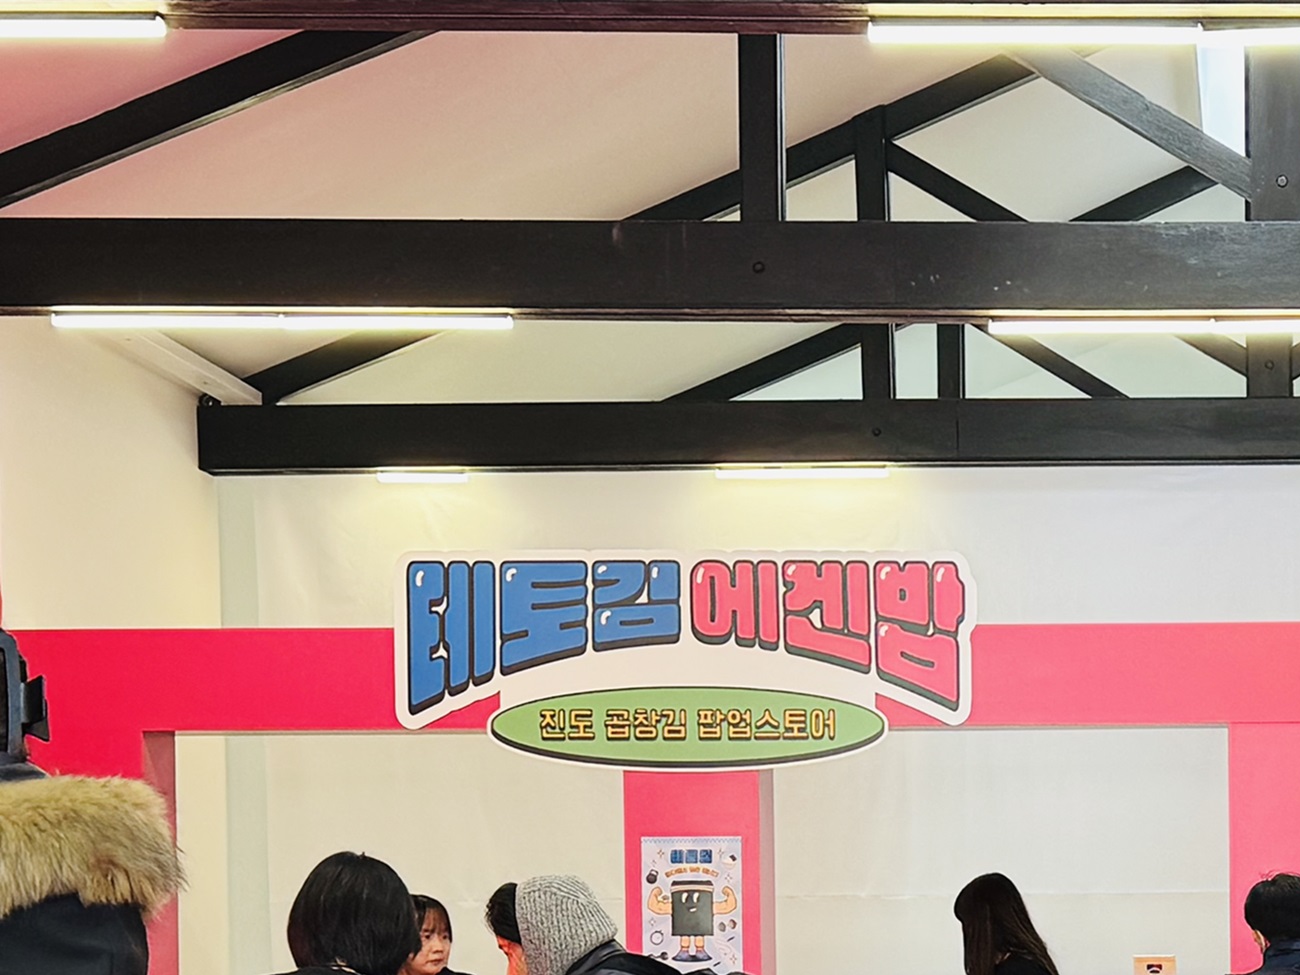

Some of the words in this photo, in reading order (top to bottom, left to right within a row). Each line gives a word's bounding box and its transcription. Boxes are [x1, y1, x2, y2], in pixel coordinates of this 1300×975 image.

[407, 560, 680, 715] 테토김
[540, 709, 595, 741] 진도
[605, 709, 687, 741] 곱창김
[697, 708, 836, 741] 팝업스토어
